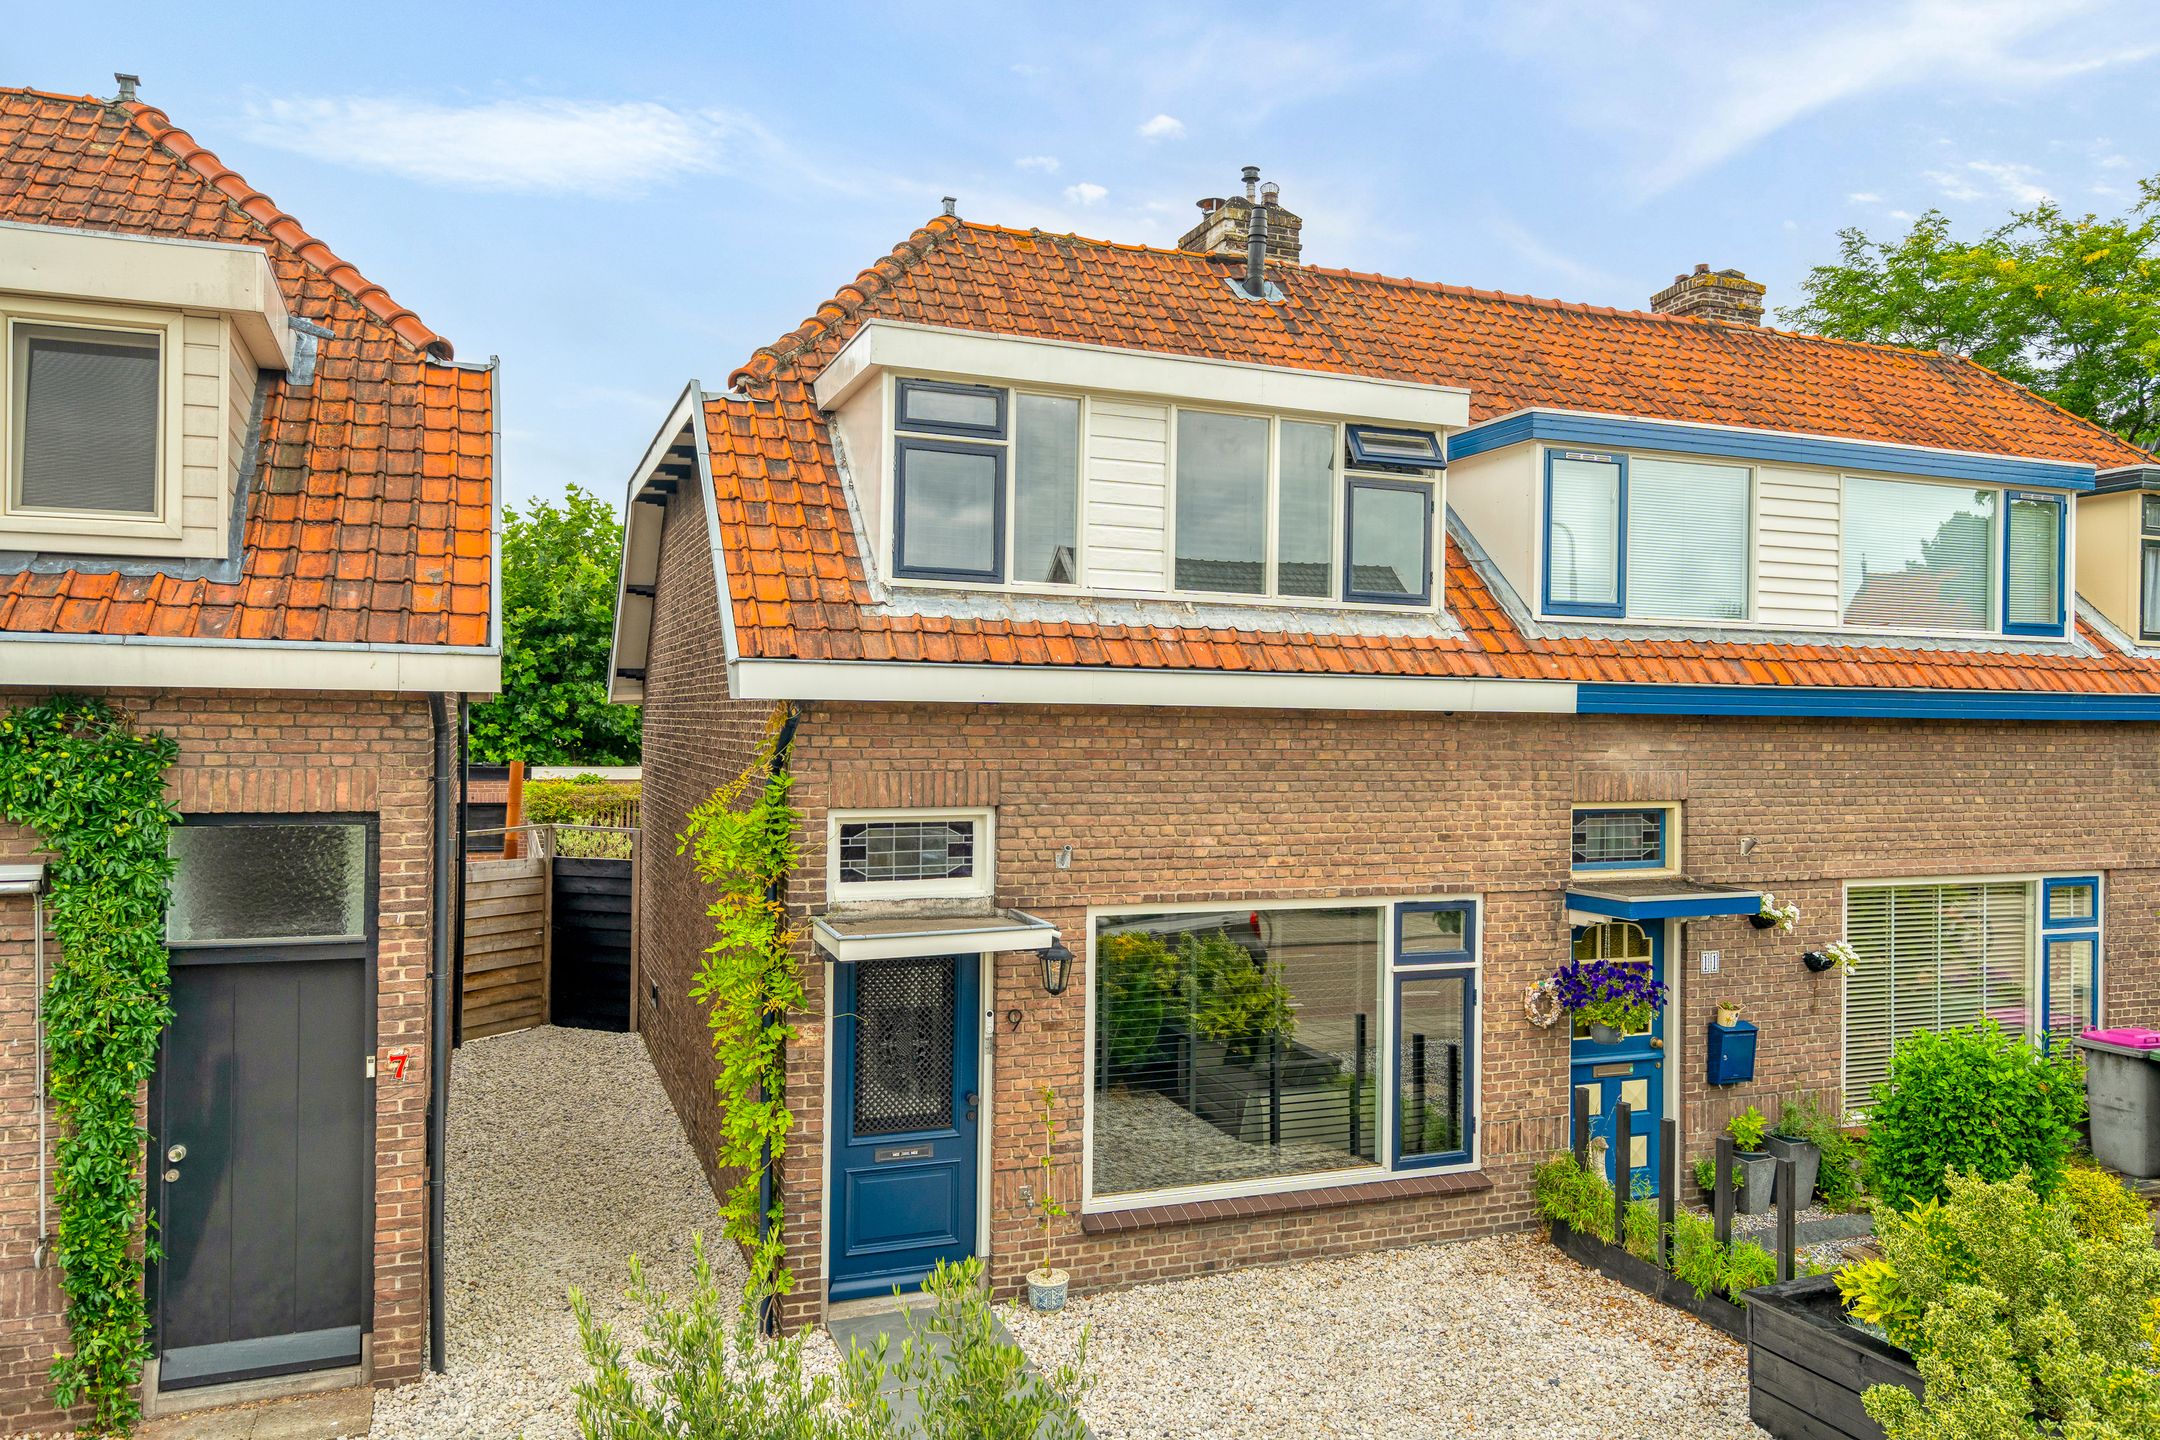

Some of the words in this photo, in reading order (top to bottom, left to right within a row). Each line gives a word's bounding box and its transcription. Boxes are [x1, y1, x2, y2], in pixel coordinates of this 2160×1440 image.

[1703, 955, 1717, 971] 11
[1007, 1008, 1023, 1032] 9
[389, 1054, 409, 1080] 7
